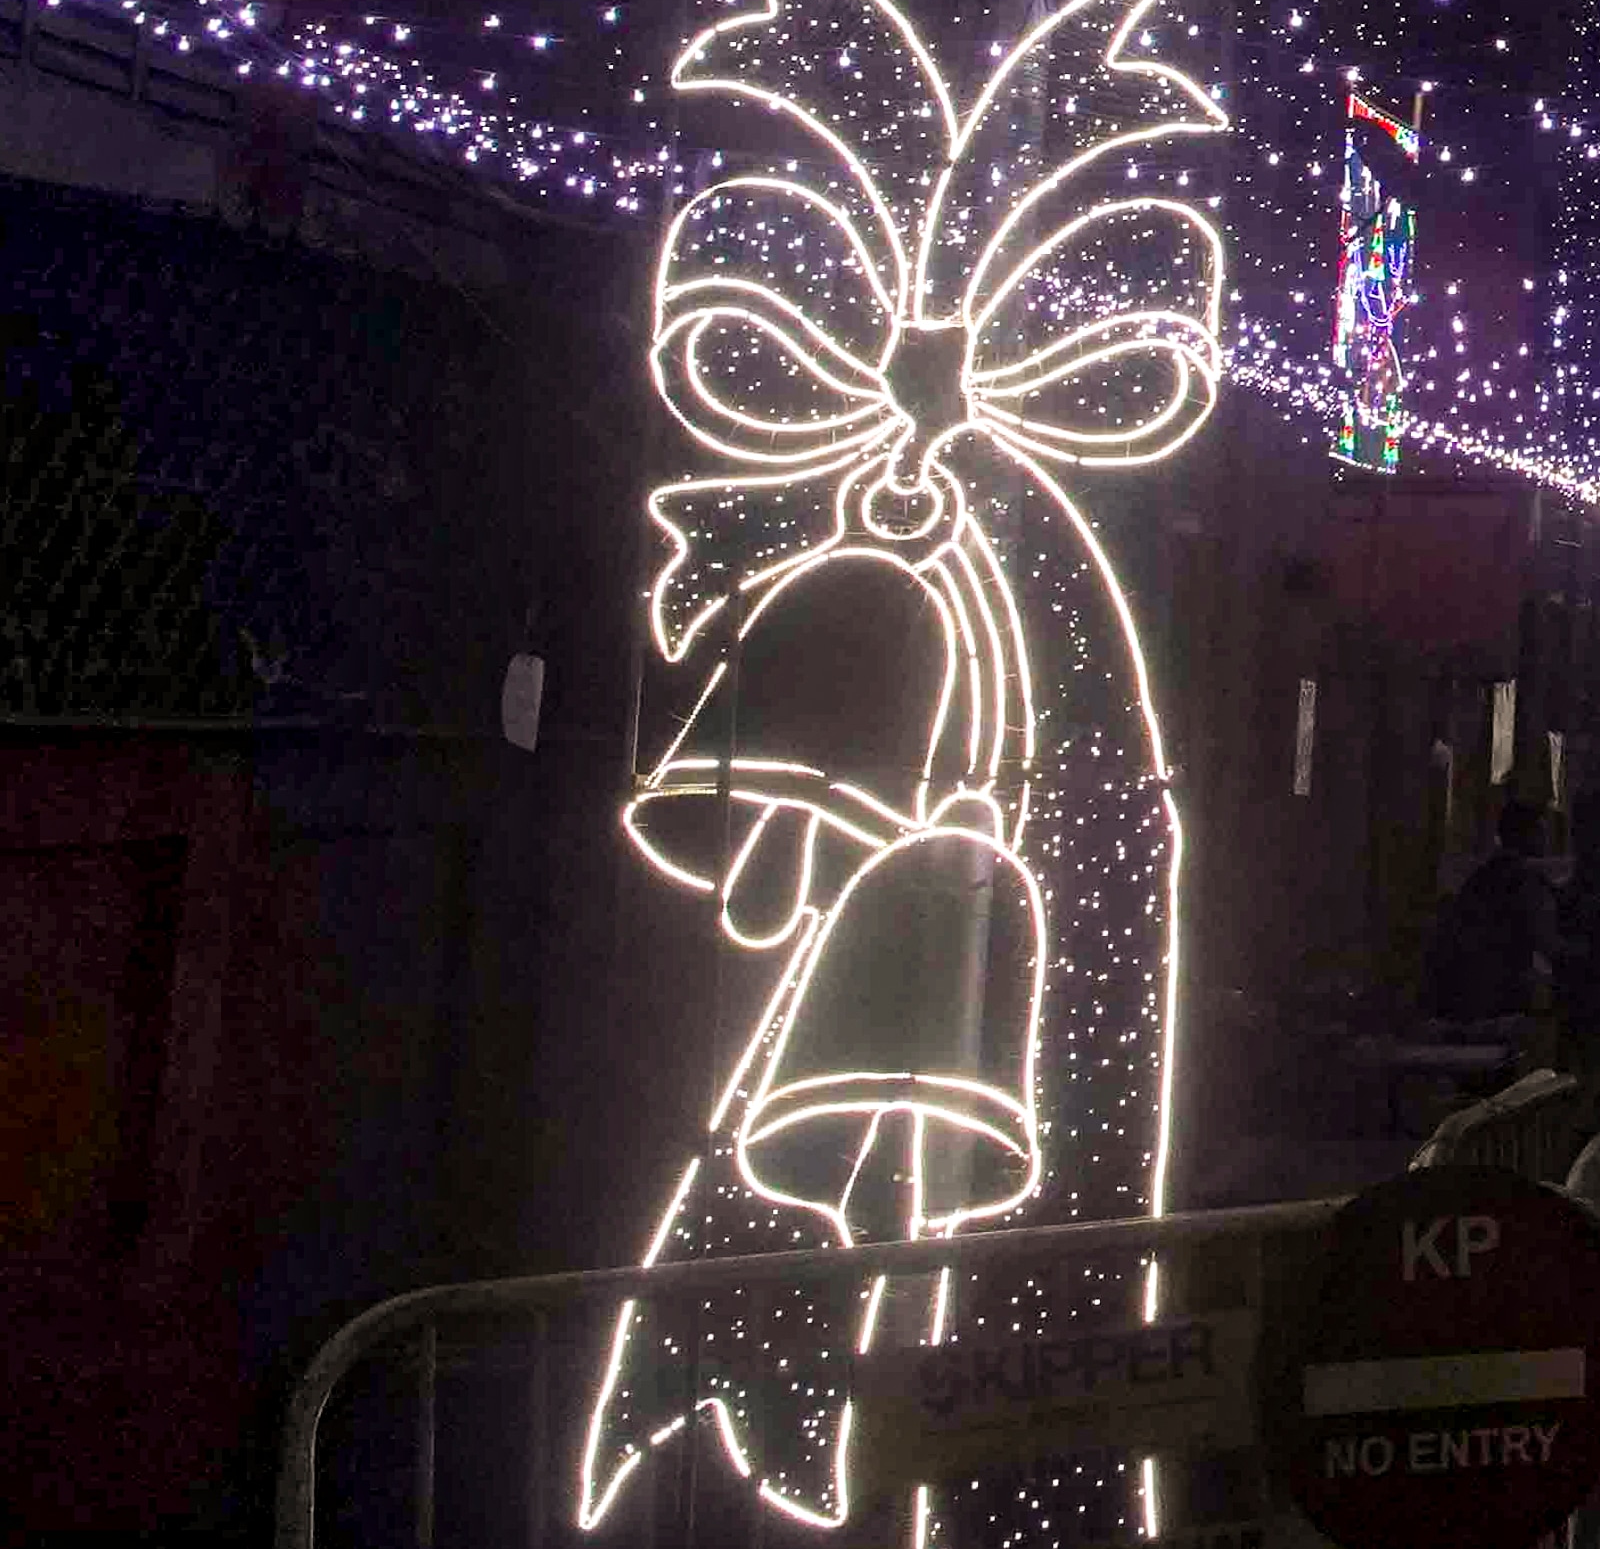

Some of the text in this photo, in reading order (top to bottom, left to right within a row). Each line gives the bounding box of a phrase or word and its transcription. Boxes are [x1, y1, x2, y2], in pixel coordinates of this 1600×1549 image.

[1402, 1213, 1502, 1282] KP
[1323, 1419, 1561, 1479] NO ENTRY
